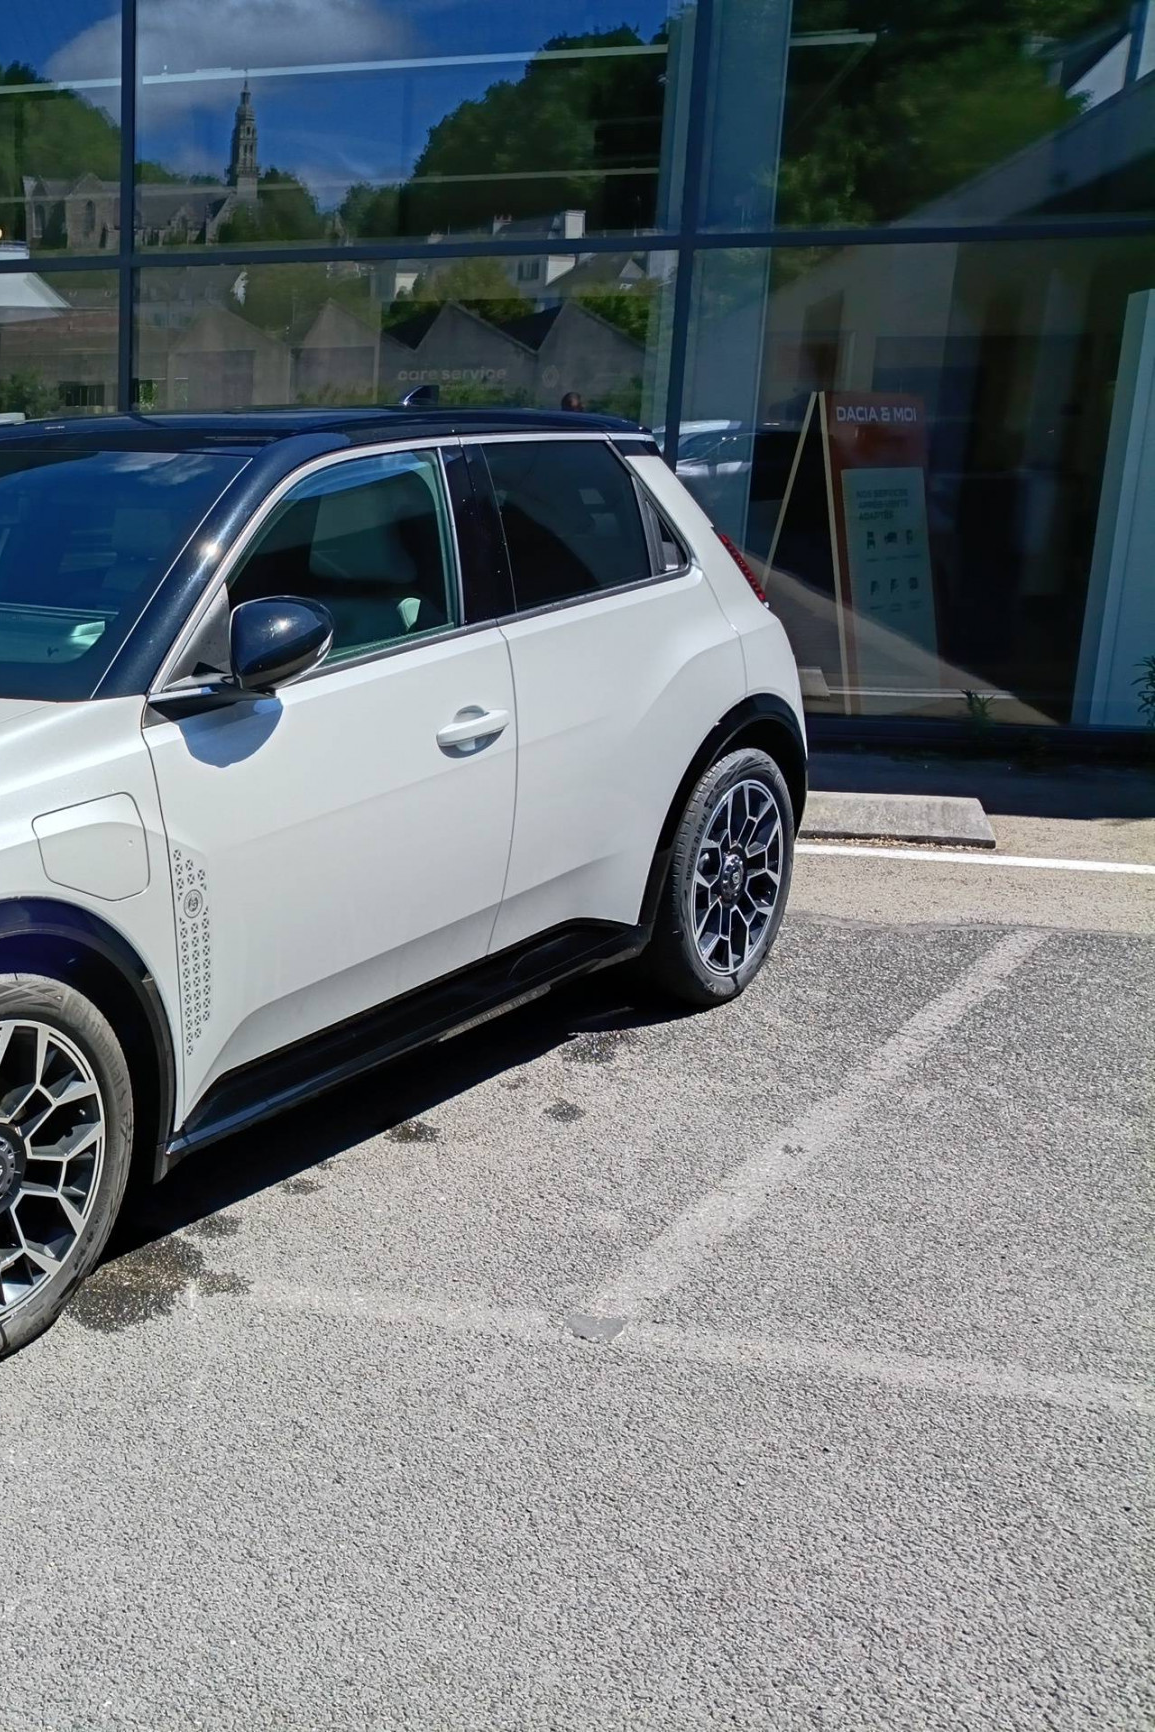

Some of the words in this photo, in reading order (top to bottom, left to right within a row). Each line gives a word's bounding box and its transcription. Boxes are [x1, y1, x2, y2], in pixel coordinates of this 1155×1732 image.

[398, 368, 438, 381] care
[441, 366, 507, 381] service
[836, 406, 878, 421] DACIA
[880, 407, 890, 421] &
[893, 407, 917, 421] MOI
